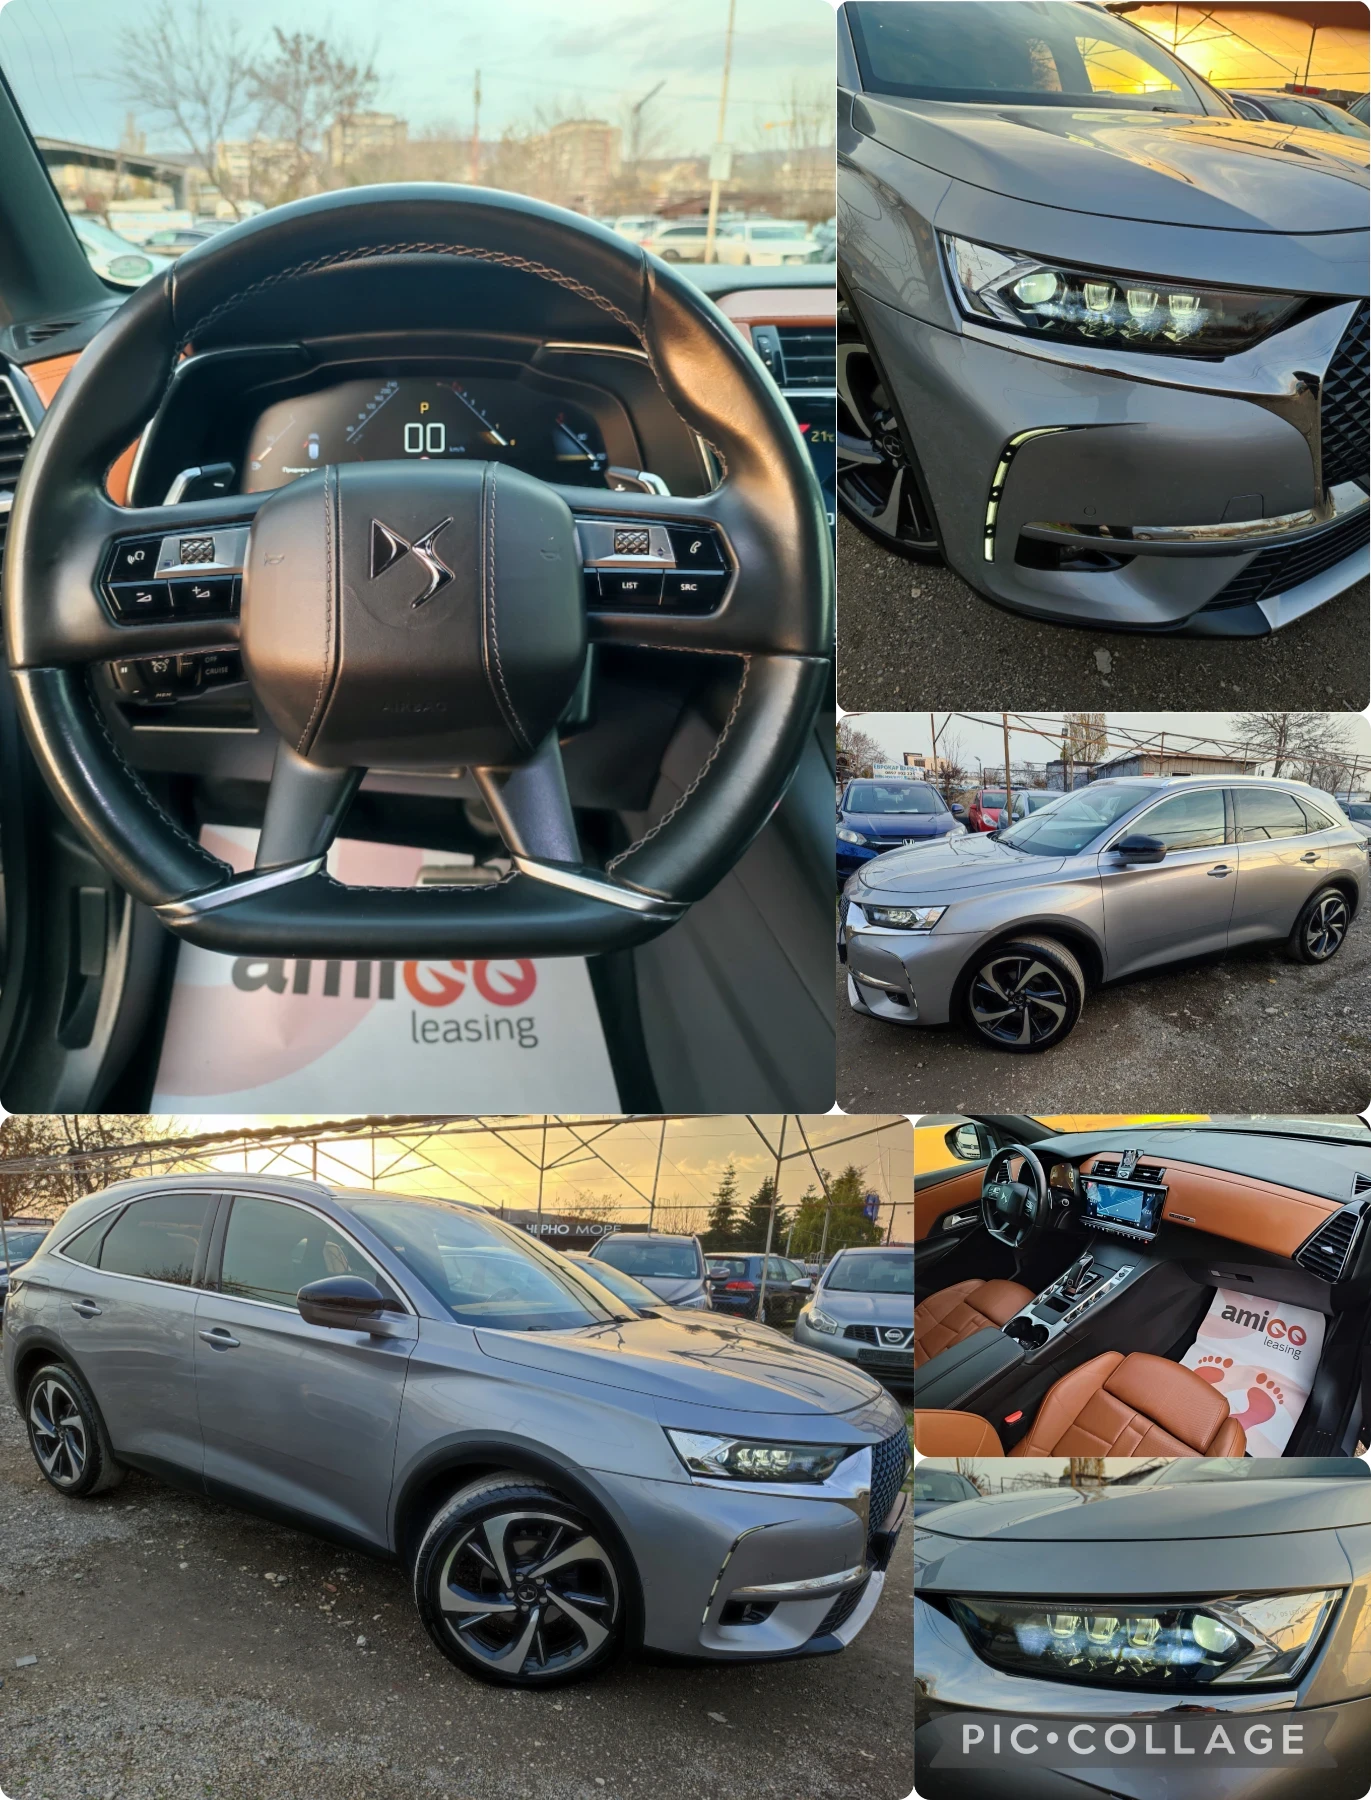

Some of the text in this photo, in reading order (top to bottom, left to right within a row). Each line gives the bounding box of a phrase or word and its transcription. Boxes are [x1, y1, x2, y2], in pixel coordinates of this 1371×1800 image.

[420, 401, 429, 414] P
[404, 422, 446, 453] 00
[621, 581, 639, 590] LIST
[680, 583, 698, 591] SRC
[205, 666, 229, 676] CRUISE
[411, 1010, 539, 1049] leasing
[1263, 1335, 1302, 1361] leasing
